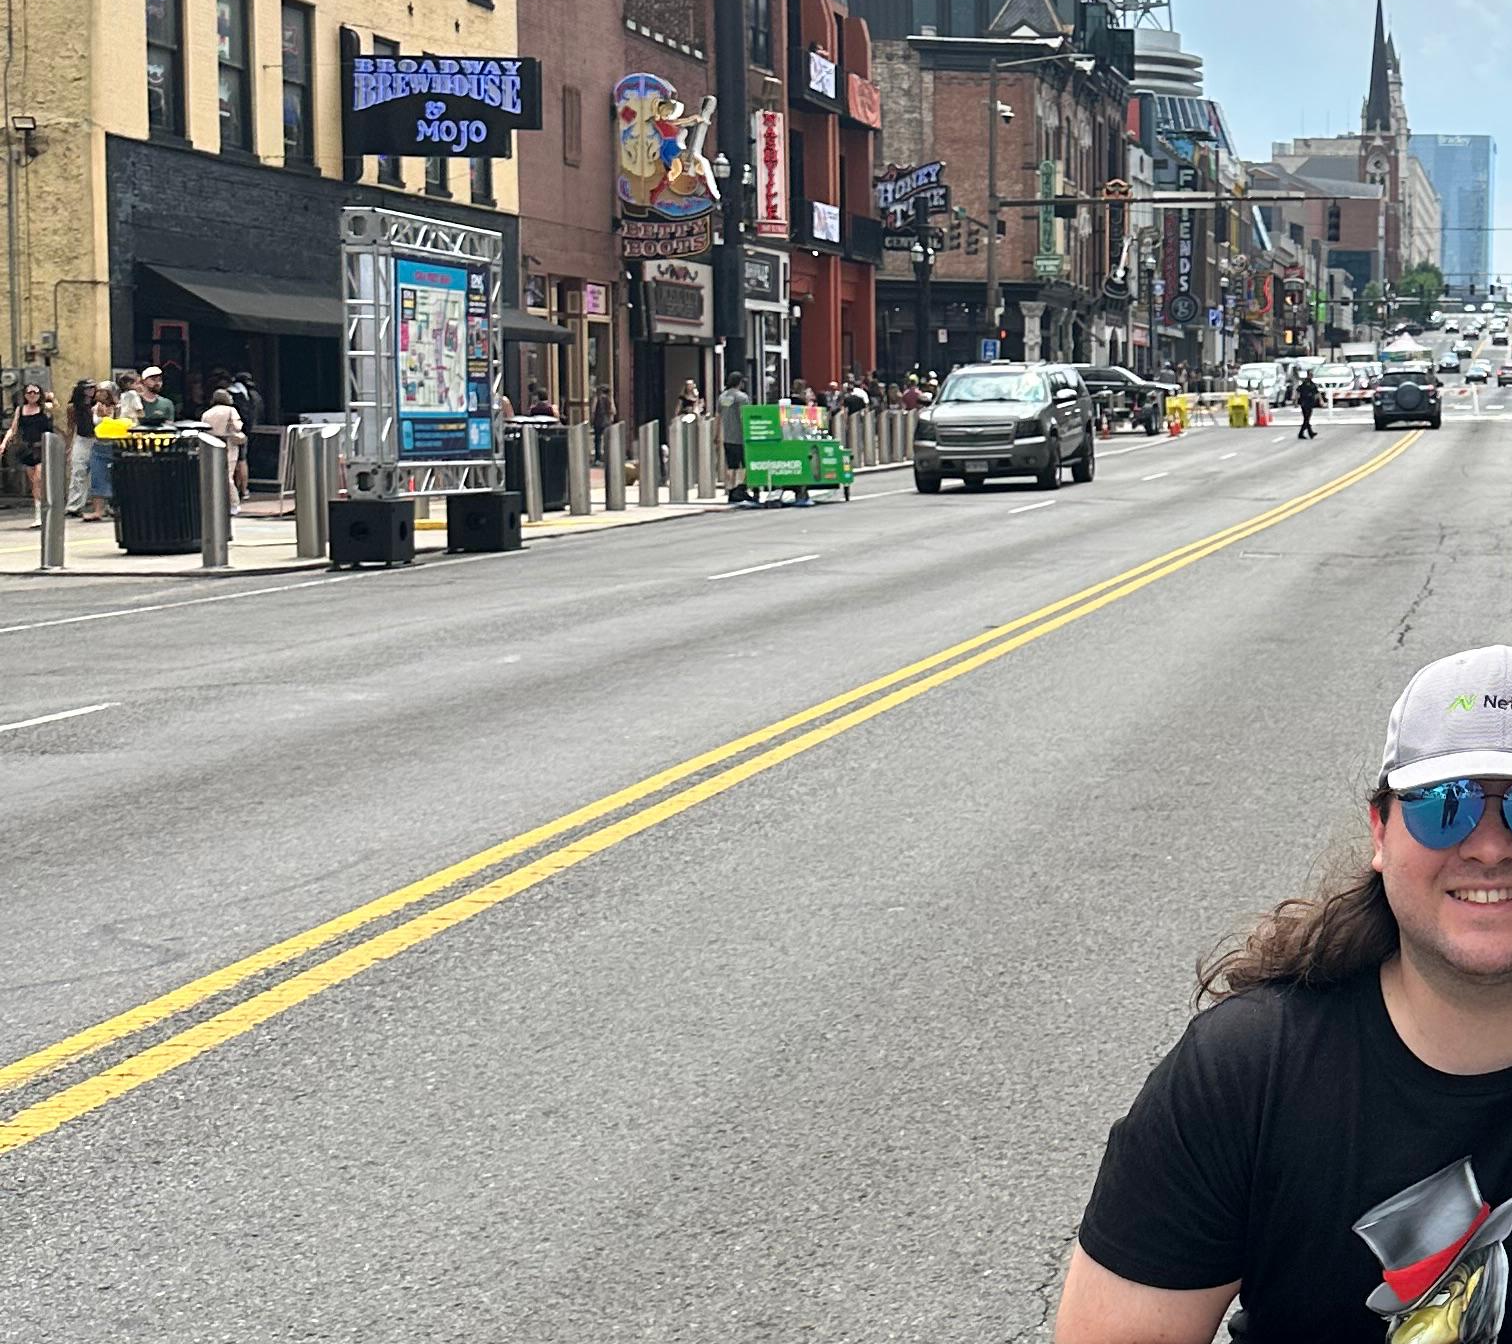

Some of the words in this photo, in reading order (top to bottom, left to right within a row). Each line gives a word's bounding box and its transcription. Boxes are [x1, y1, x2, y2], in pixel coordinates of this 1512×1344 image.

[352, 58, 523, 75] BROADWAY
[352, 72, 522, 114] BREWHOUSE
[415, 119, 488, 153] MOJO
[876, 161, 943, 209] HONKY
[622, 219, 708, 239] BETTY
[1179, 169, 1194, 293] FIENDS
[624, 236, 708, 257] BOOTS
